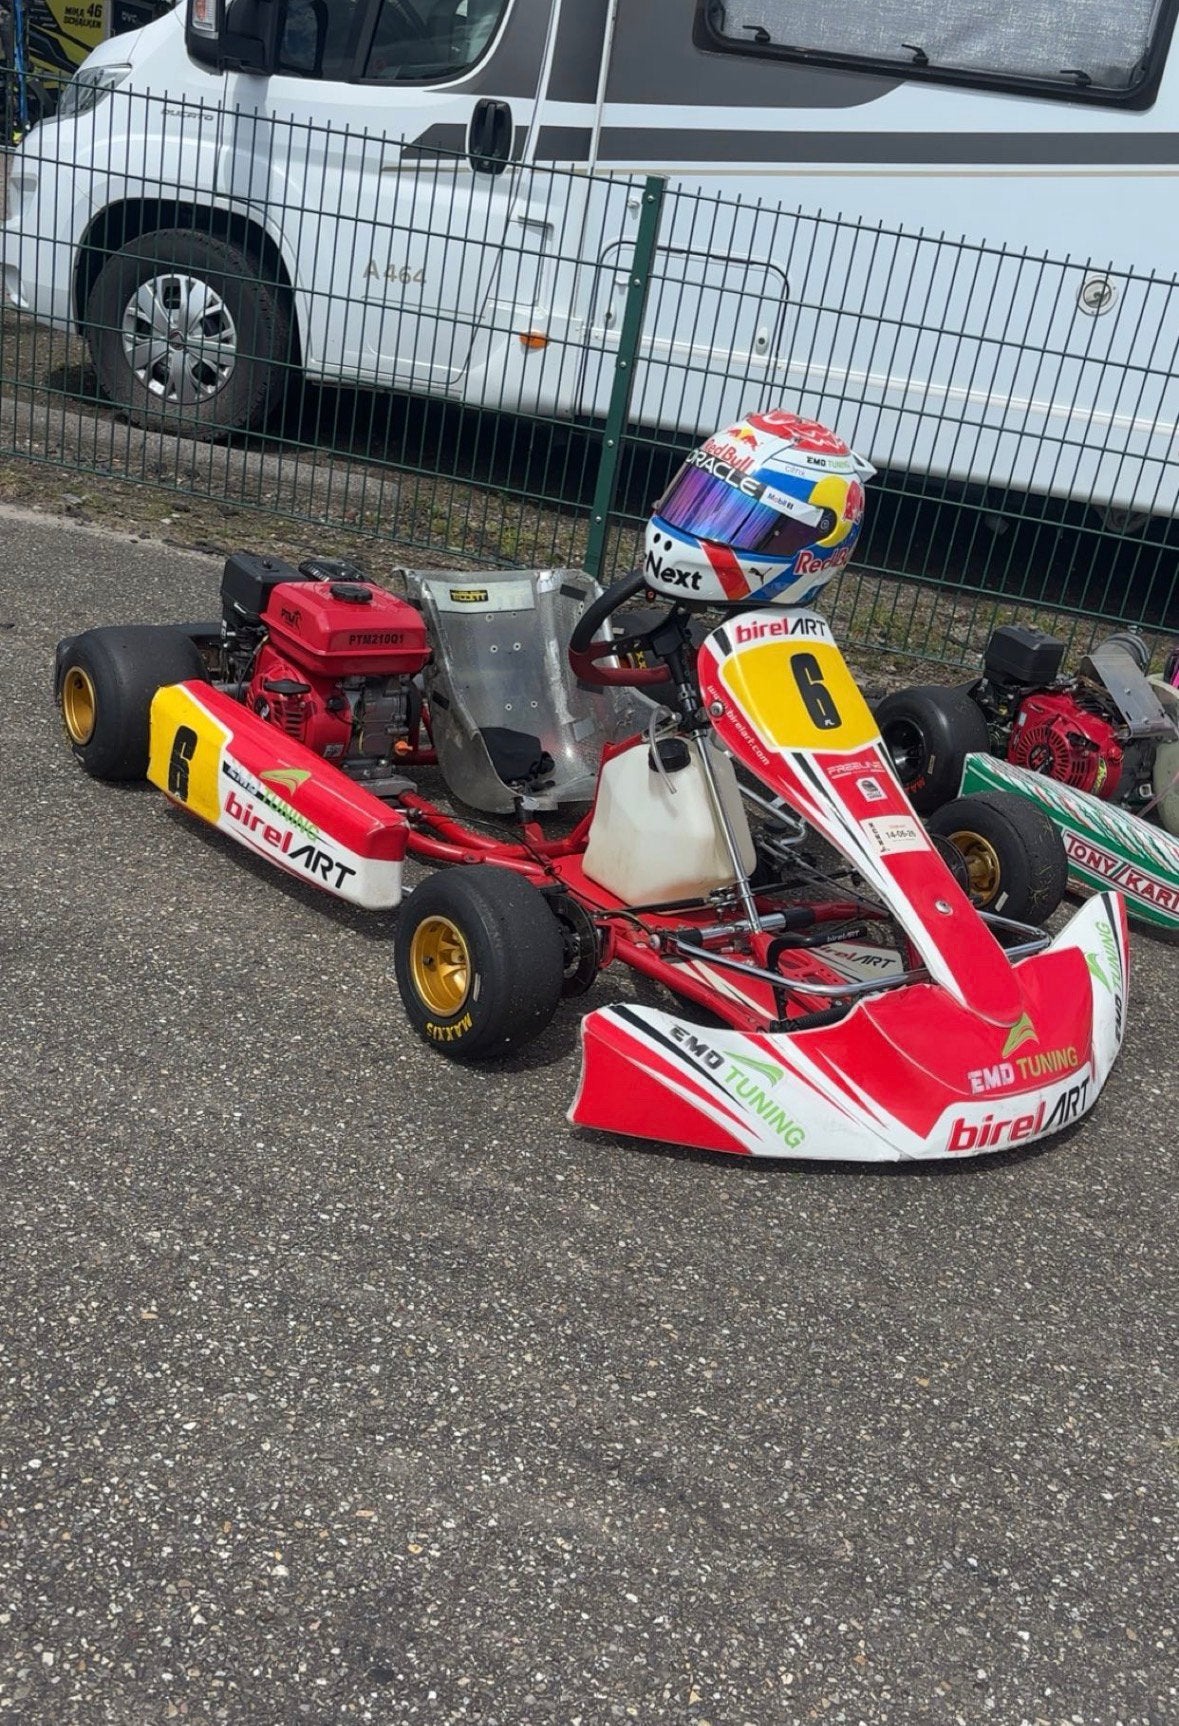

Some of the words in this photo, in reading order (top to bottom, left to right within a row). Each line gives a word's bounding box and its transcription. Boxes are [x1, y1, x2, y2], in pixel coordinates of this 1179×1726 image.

[86, 3, 103, 18] 46
[161, 108, 214, 121] DUCATO
[685, 449, 761, 497] ORACLE
[806, 456, 826, 467] EMD
[735, 617, 826, 644] birelART
[789, 652, 843, 731] 6
[168, 724, 198, 802] 6
[224, 791, 357, 890] birelART
[426, 1012, 473, 1042] MAXXIS
[669, 1025, 725, 1070] EMD
[723, 1065, 806, 1149] TUNING
[967, 1062, 1016, 1095] EMD
[1016, 1046, 1079, 1080] TUNING
[947, 1076, 1091, 1152] birelART
